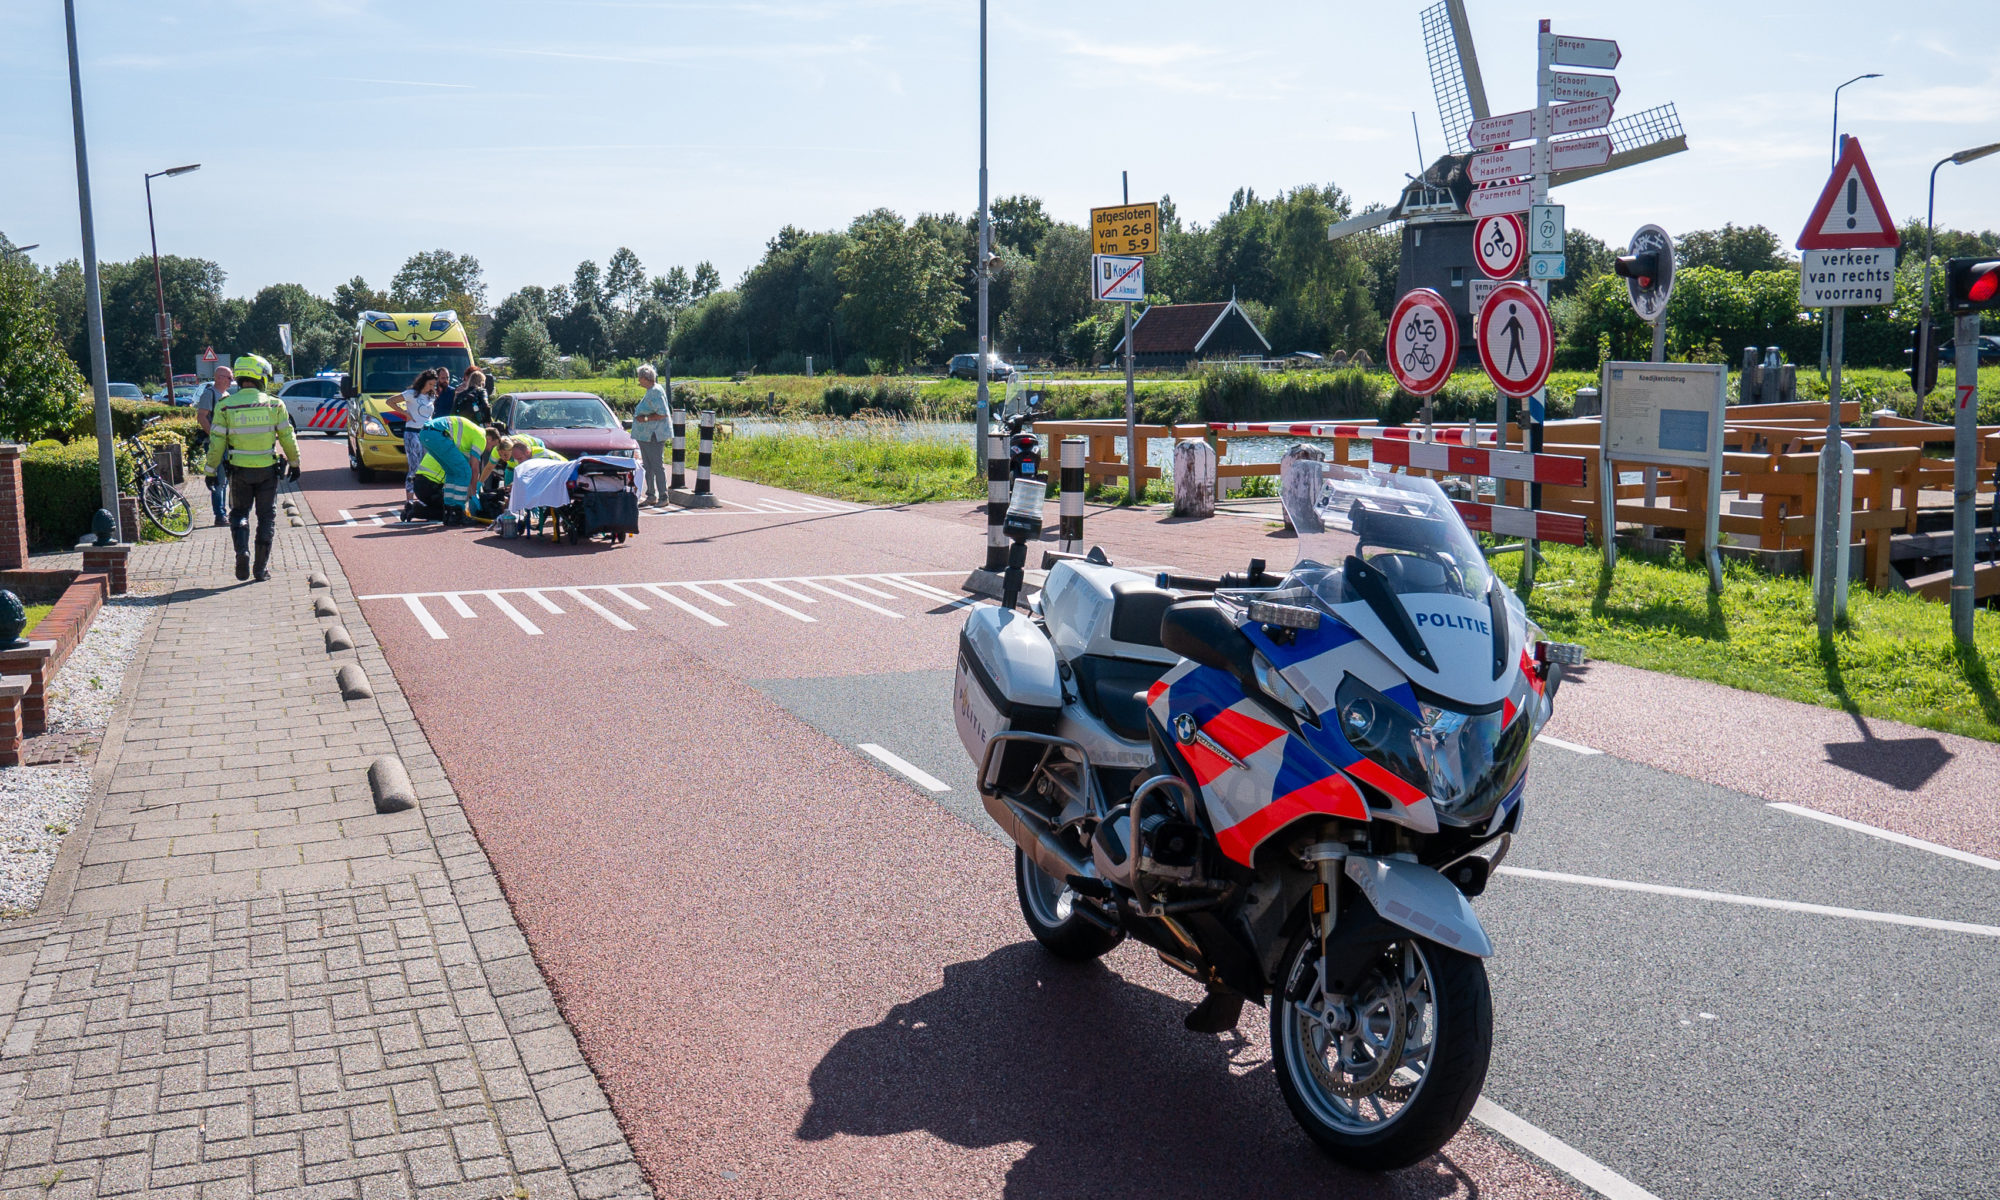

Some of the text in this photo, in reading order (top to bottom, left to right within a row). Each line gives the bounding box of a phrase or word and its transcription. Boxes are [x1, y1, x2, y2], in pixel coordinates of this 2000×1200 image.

[1558, 39, 1586, 51] Bergen
[1557, 75, 1587, 86] Schoorl
[1556, 87, 1599, 98] Den Helder
[1561, 103, 1599, 116] Geestmer-
[1480, 118, 1514, 130] Centrum
[1567, 114, 1600, 127] ambacht
[1480, 129, 1511, 142] Egmond
[1553, 140, 1600, 153] Warmenhuizen
[1480, 155, 1504, 165] Heiloo
[1480, 165, 1512, 176] Haarlem
[1479, 188, 1521, 200] Purmerend
[1096, 209, 1151, 225] afgesloten
[1098, 222, 1152, 239] van 26-8
[1543, 225, 1553, 234] 71
[1100, 238, 1149, 254] t/m 5-9
[1821, 252, 1880, 266] verkeer
[1113, 264, 1140, 282] Koedijk
[1809, 268, 1890, 283] van rechts
[1815, 287, 1882, 302] voorrang
[1957, 385, 1975, 409] 7
[1415, 612, 1490, 636] POLITIE
